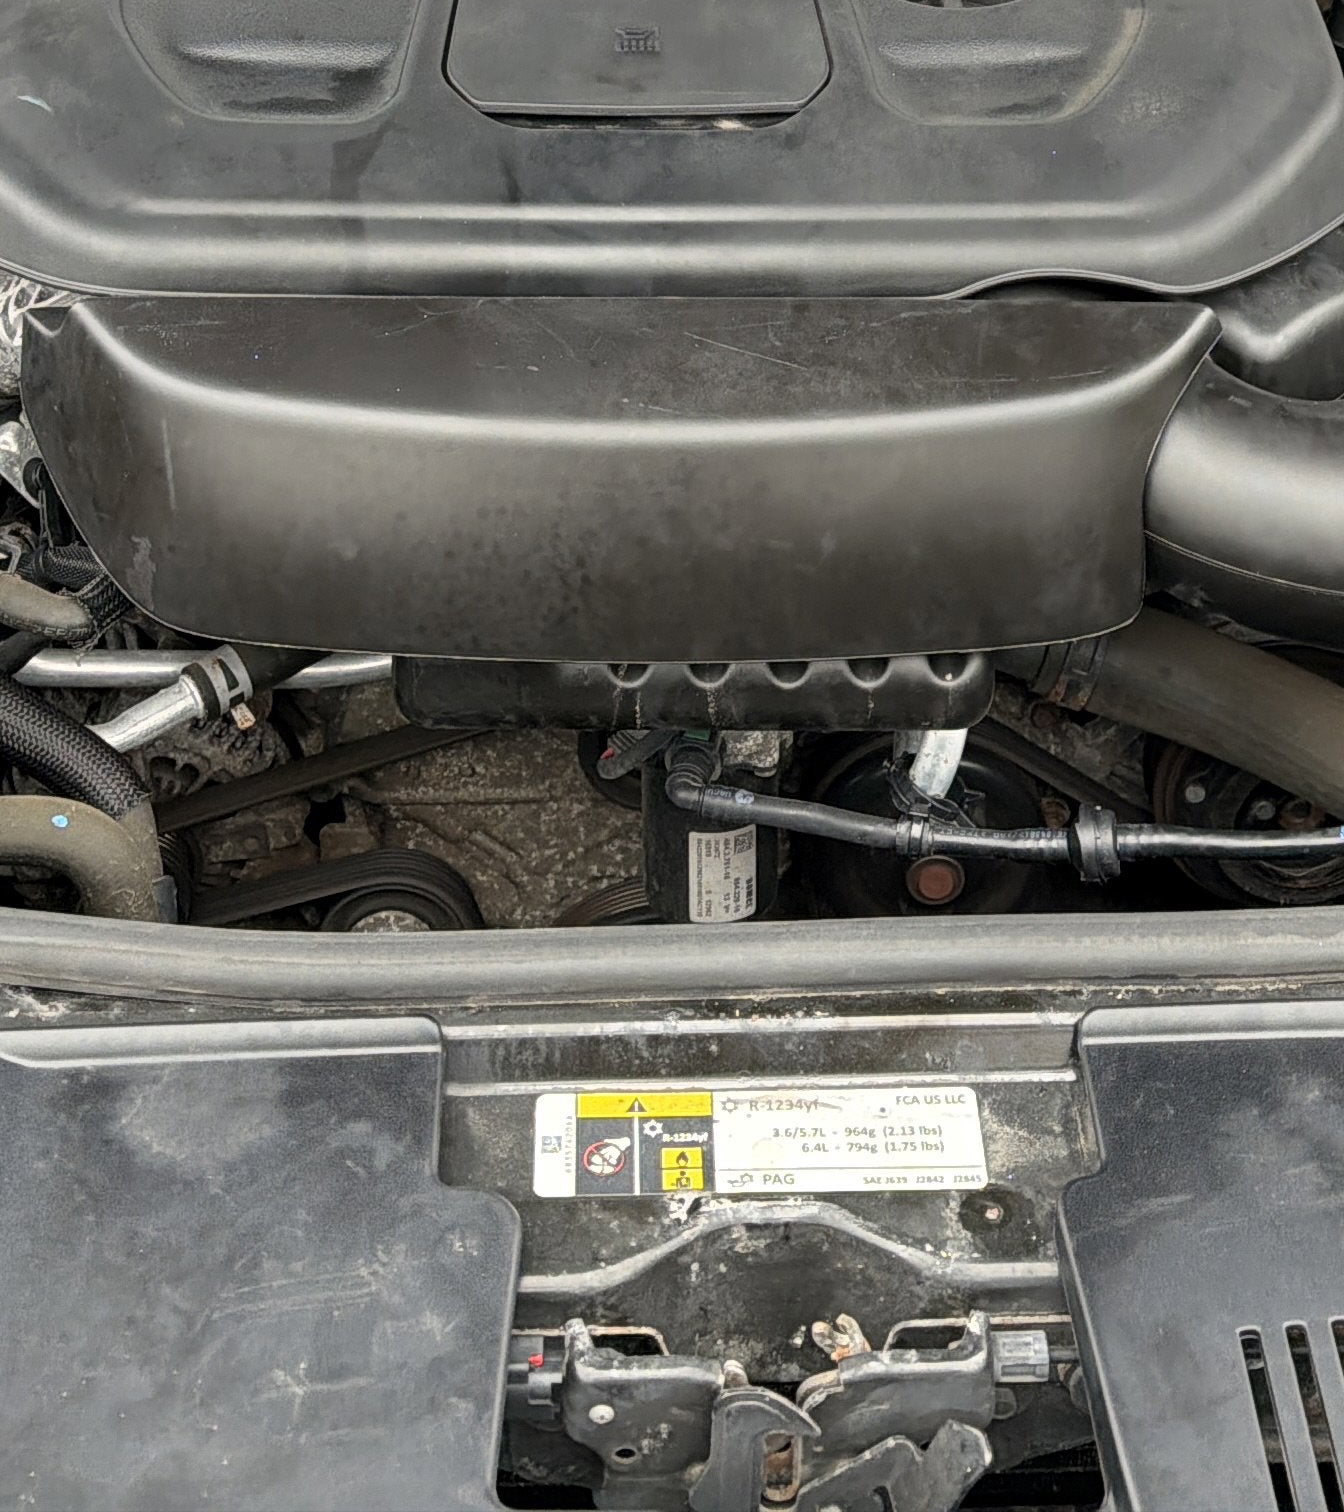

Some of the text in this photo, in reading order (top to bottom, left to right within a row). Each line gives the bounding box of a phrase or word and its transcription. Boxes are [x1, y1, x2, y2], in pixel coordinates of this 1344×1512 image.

[749, 1098, 818, 1114] R-1234yf
[895, 1093, 967, 1105] FCA US LLC
[772, 1127, 827, 1140] 3.6/5.7L
[844, 1126, 877, 1139] 964g
[882, 1125, 916, 1138] (2.13
[918, 1124, 943, 1138] lbs)
[801, 1142, 830, 1153] 6.4L
[846, 1142, 879, 1155] 794g
[884, 1140, 918, 1154] (1.75
[920, 1139, 945, 1153] lbs)
[762, 1173, 796, 1185] PAG
[862, 1176, 882, 1185] SAE
